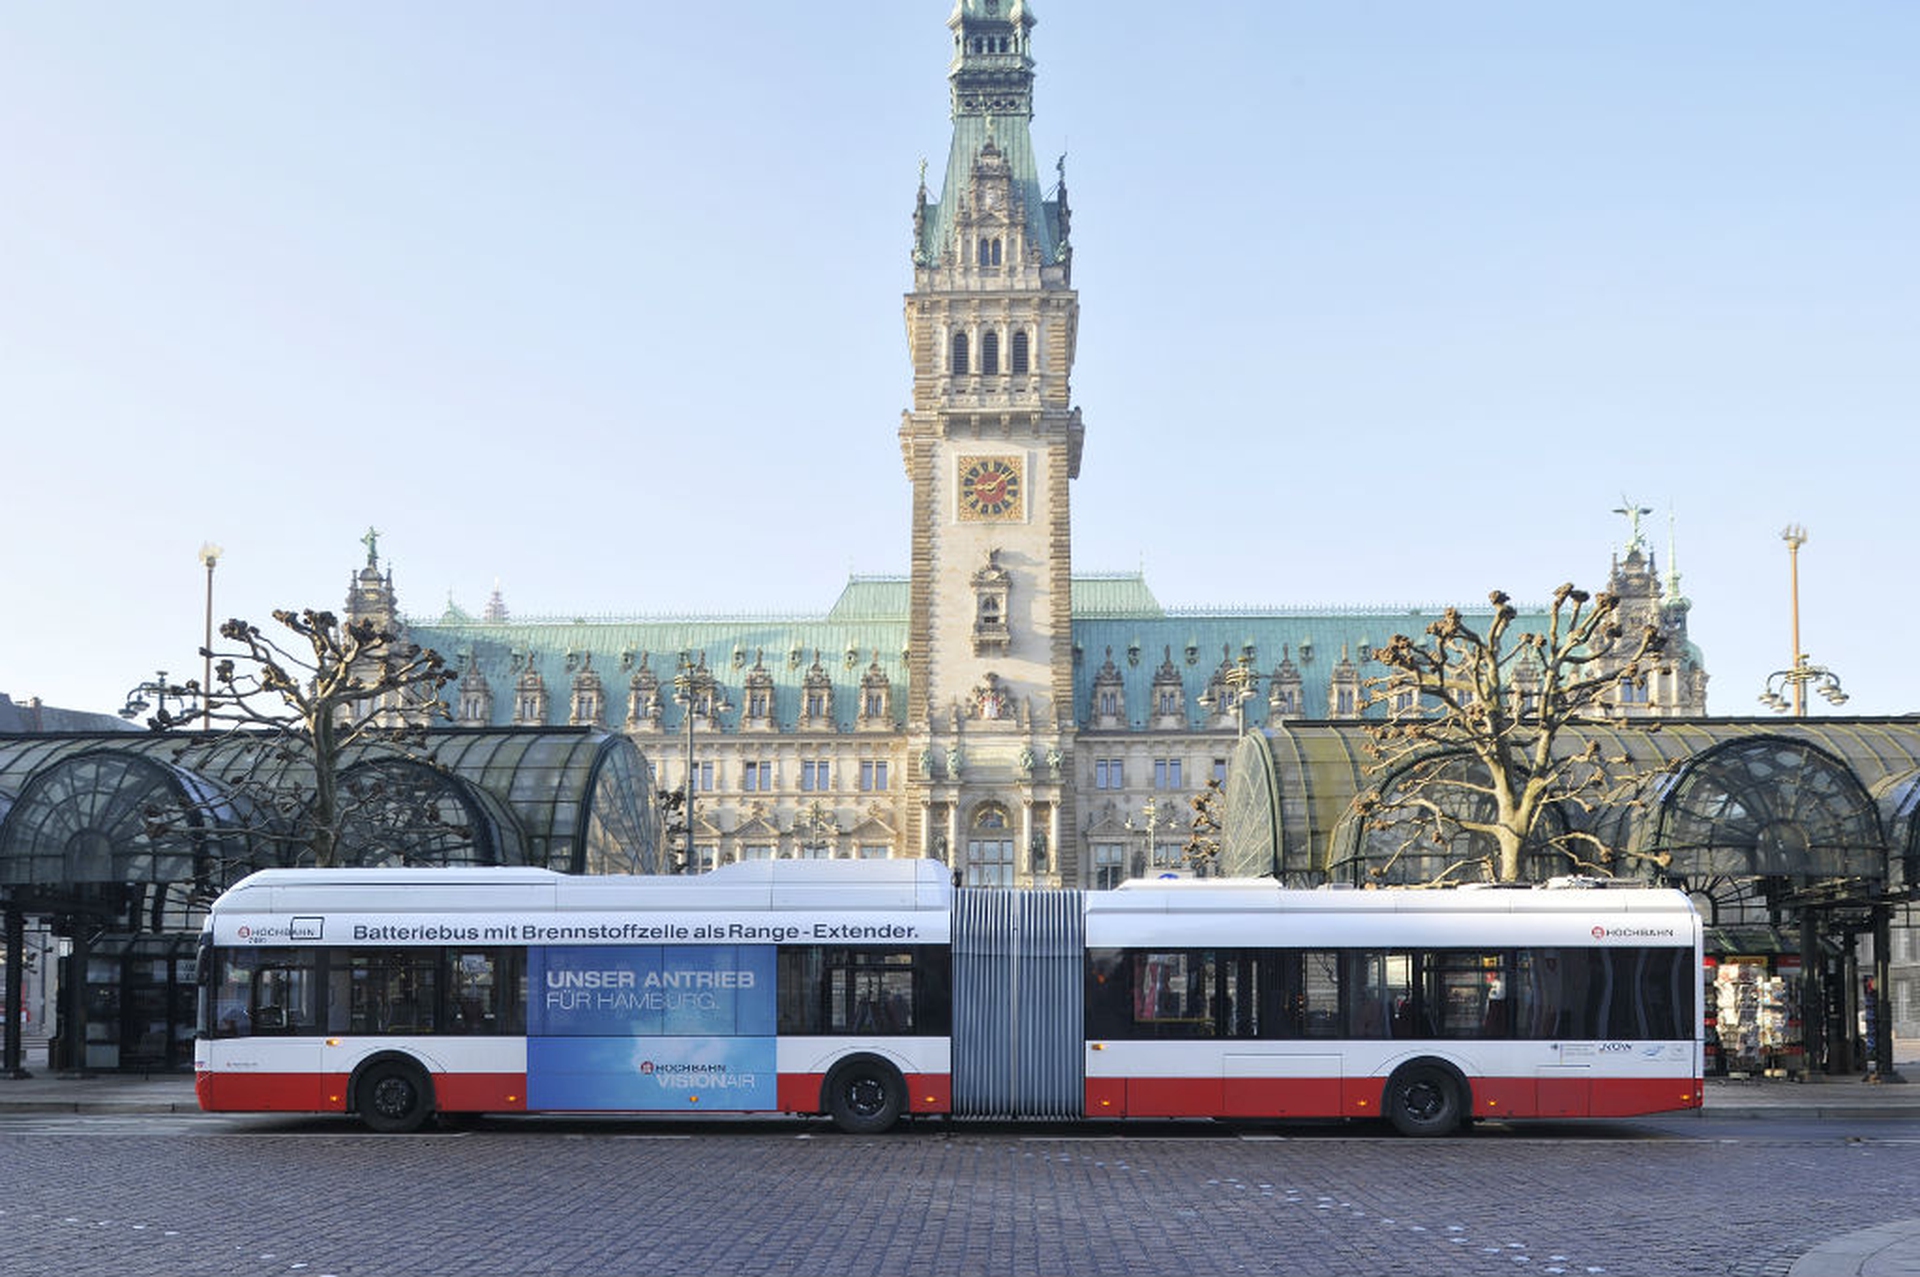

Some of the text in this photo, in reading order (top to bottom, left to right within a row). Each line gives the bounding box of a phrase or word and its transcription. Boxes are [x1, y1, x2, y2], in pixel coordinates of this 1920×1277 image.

[353, 925, 479, 940] Batteriebus
[484, 925, 517, 940] mit
[522, 924, 689, 940] Brennstoffzelle
[693, 924, 724, 939] als
[1606, 928, 1674, 937] HOCHBAHN
[547, 971, 754, 988] UNSER ANTRIEB
[547, 990, 590, 1010] FÜR
[656, 1064, 726, 1073] HOCHBAHN
[659, 1074, 755, 1088] VISIONAIR
